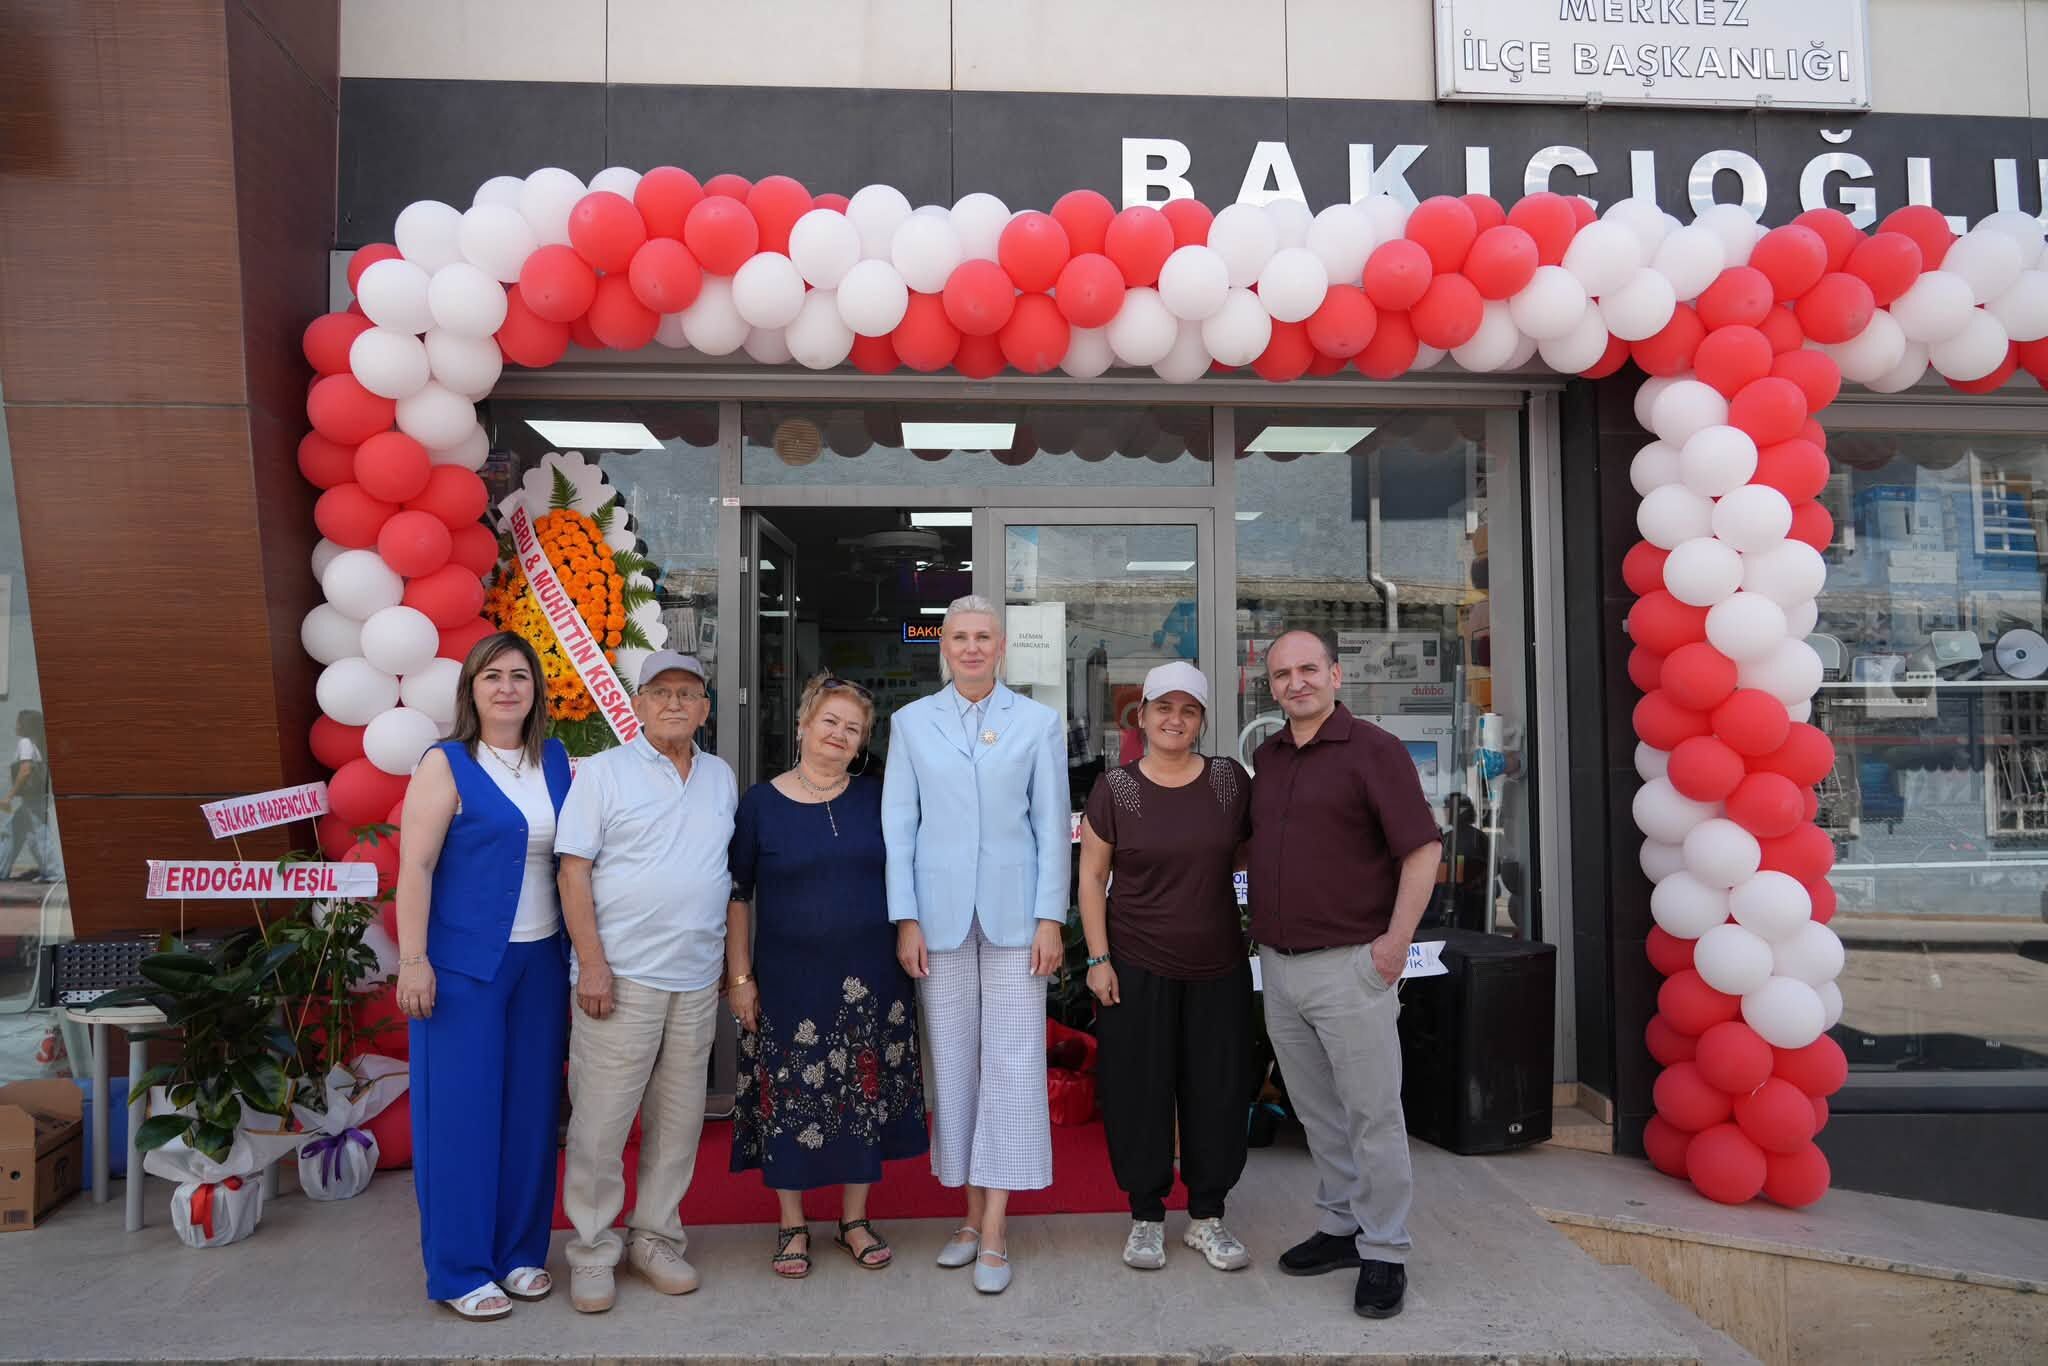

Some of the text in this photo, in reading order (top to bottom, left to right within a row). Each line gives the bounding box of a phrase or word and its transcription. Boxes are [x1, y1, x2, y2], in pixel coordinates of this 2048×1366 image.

[1559, 0, 1749, 26] MERKEZ
[1463, 29, 1850, 86] İLÇE BAŞKANLIĞI
[510, 506, 533, 554] EBRU
[525, 553, 541, 571] &
[532, 569, 597, 664] MUHİTTİN
[215, 786, 321, 833] SİLKAR MADENCİLİK
[166, 862, 273, 892] ERDOĞAN
[281, 864, 338, 896] YEŞİL
